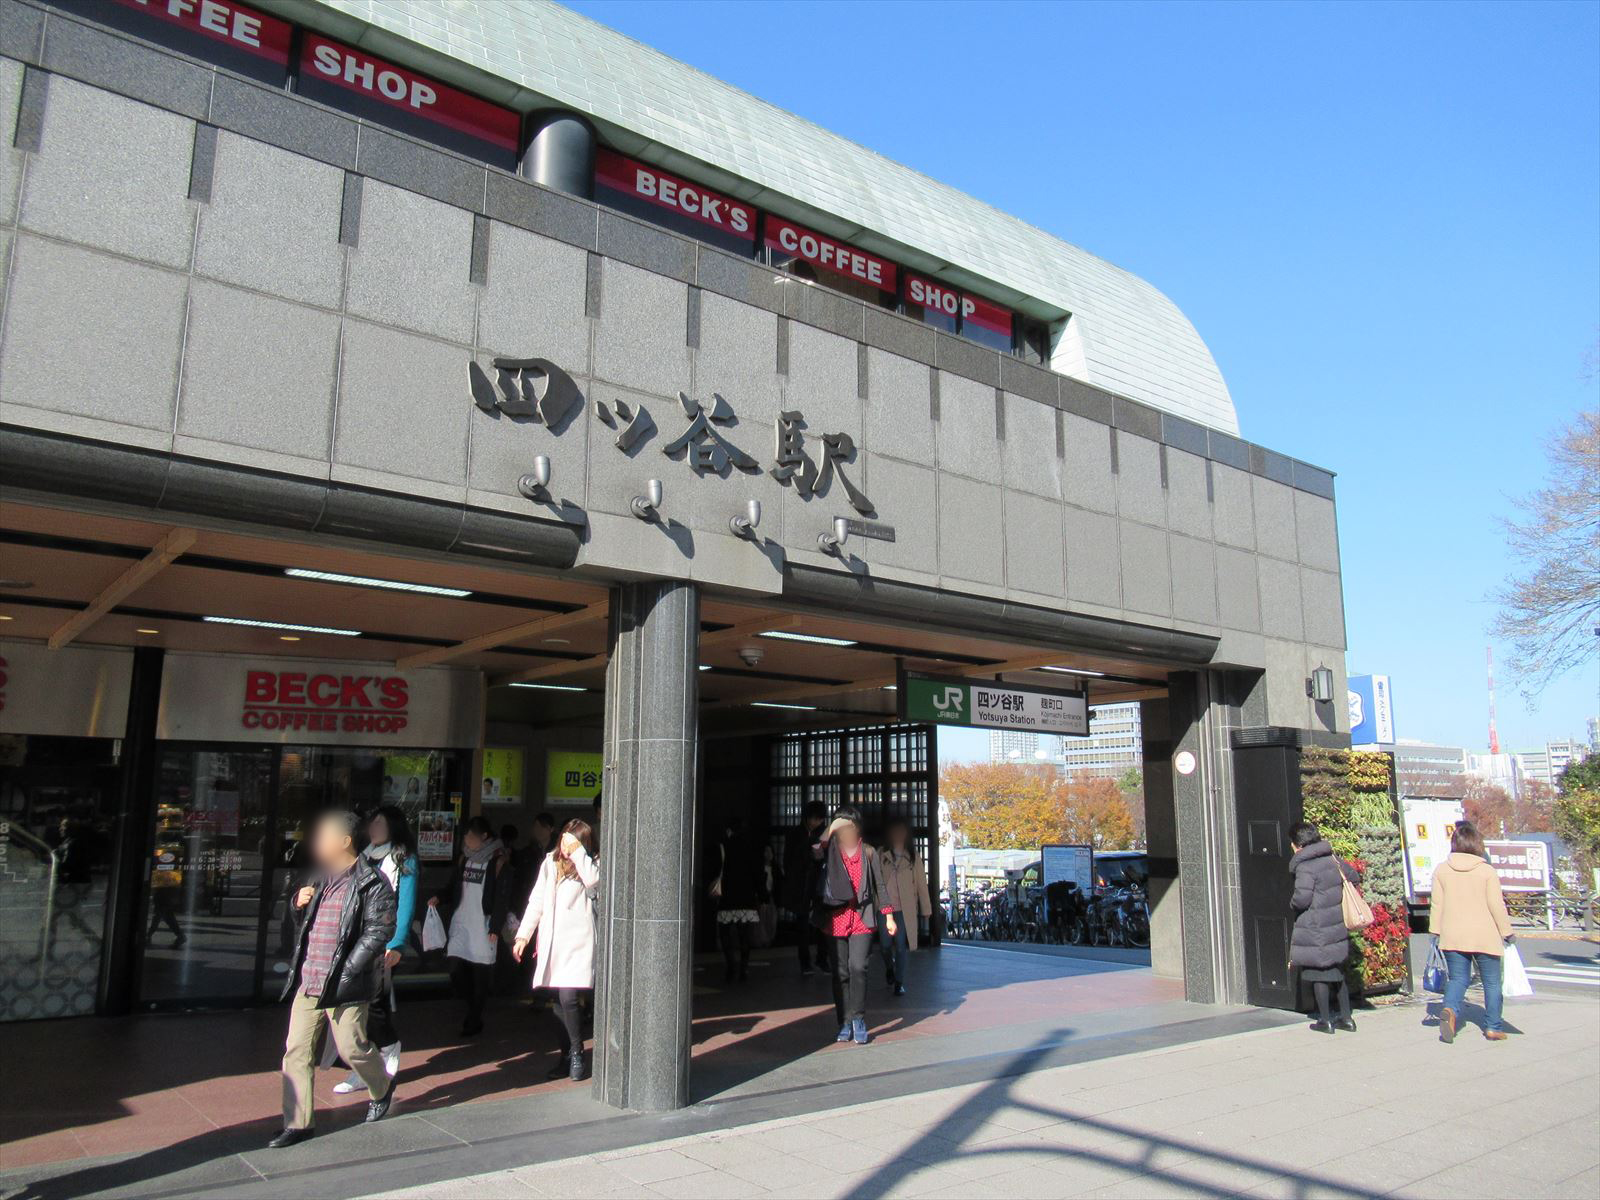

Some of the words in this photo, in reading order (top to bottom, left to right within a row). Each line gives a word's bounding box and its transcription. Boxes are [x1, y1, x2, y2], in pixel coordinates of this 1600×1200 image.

[313, 45, 437, 109] SHOP
[636, 169, 749, 233] BECK'S
[779, 227, 882, 284] COFFEE
[910, 280, 976, 318] SHOP
[467, 358, 876, 514] 四ツ谷駅
[245, 671, 409, 709] BECK'S
[932, 686, 964, 712] JR
[977, 691, 1024, 712] 四ツ谷駅
[241, 711, 338, 732] COFFEE
[341, 715, 408, 734] SHOP
[978, 712, 1009, 725] Yotsuya
[1010, 713, 1036, 725] Station
[1063, 713, 1082, 721] Entrance
[565, 771, 602, 788] 四谷
